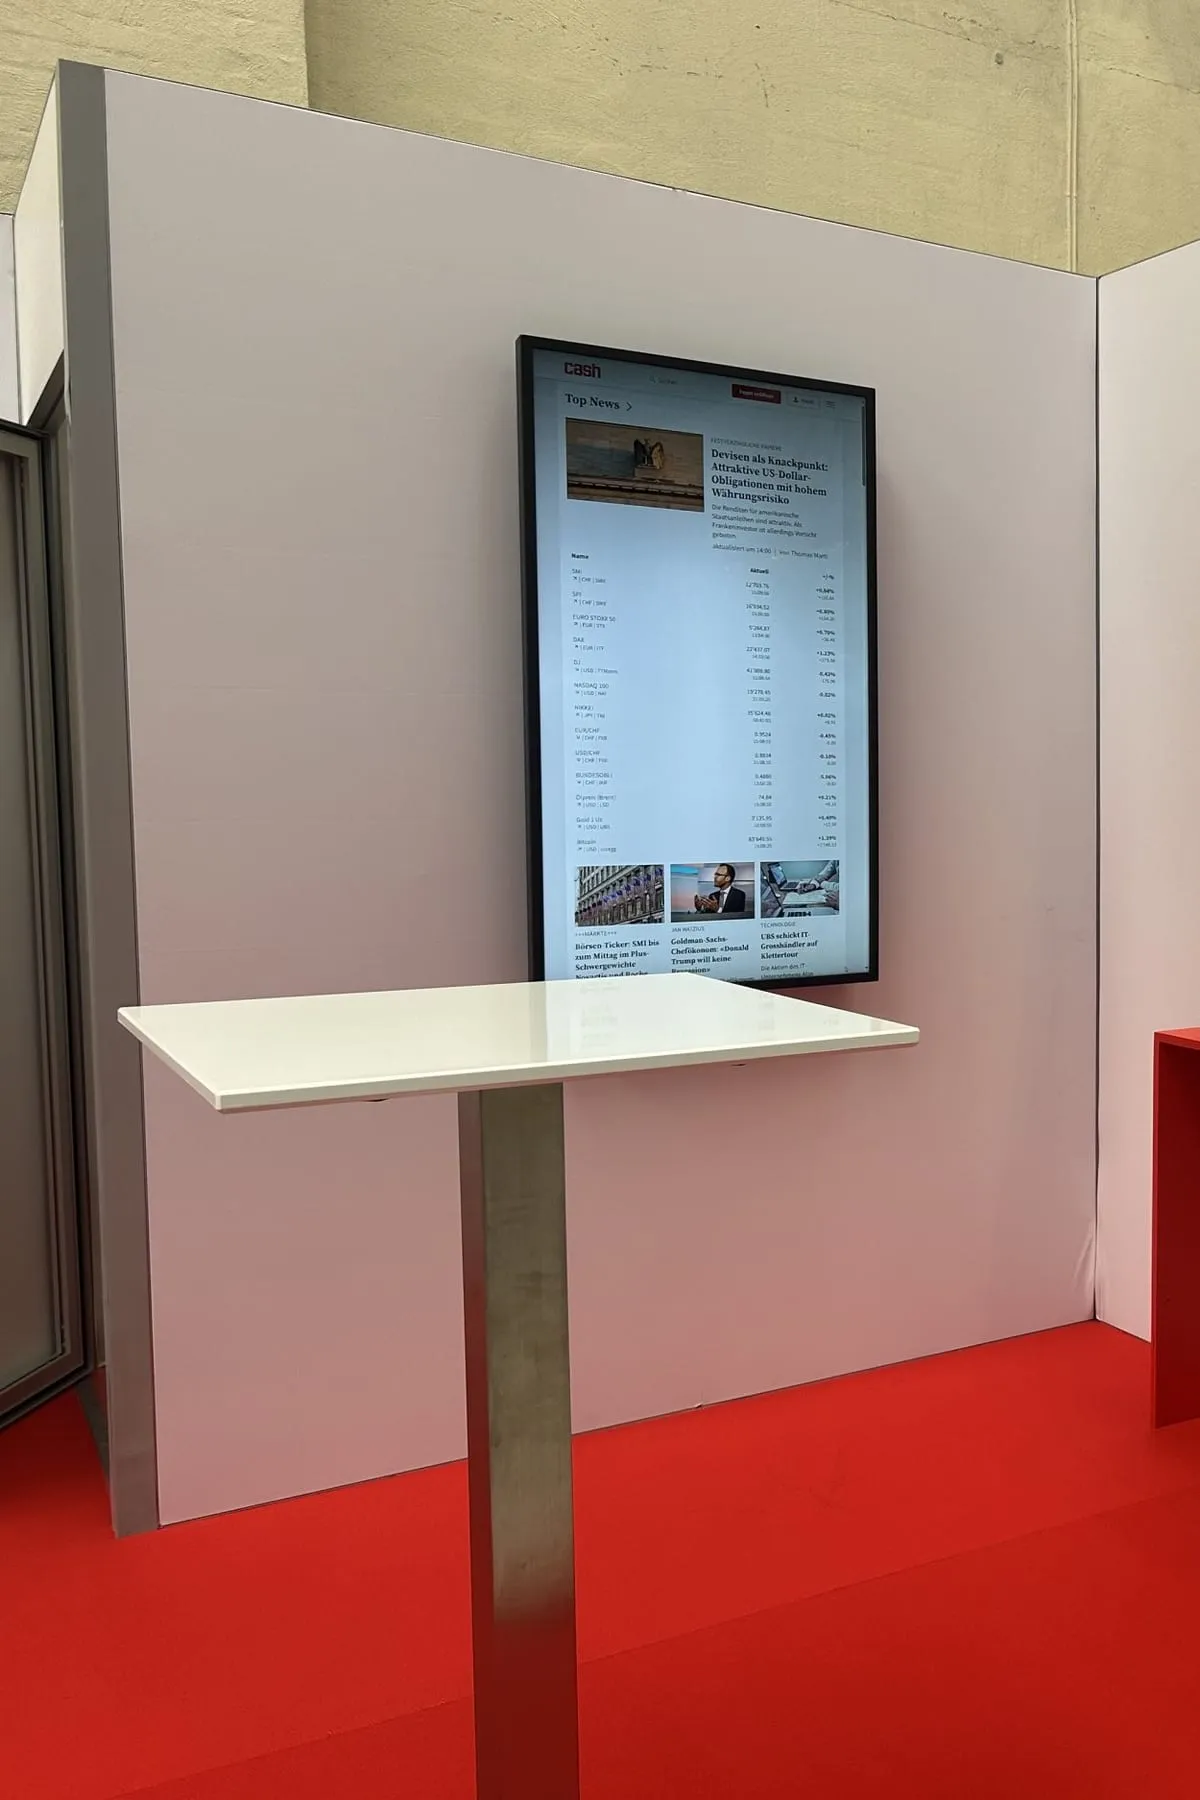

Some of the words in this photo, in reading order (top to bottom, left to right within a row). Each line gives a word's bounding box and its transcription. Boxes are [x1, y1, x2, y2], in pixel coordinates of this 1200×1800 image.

[564, 362, 601, 378] cash
[565, 393, 587, 407] Top
[590, 396, 620, 410] News
[711, 449, 750, 461] Devisen
[751, 454, 766, 464] als
[768, 456, 828, 471] Knackpunkt:
[711, 463, 760, 475] Attraktive
[762, 468, 811, 481] US-Dollar-
[711, 475, 774, 490] Obligationen
[776, 483, 792, 492] mit
[794, 484, 827, 496] hohem
[712, 488, 790, 504] Währungsrisiko
[760, 932, 775, 940] UBS
[648, 938, 660, 946] bis
[760, 941, 805, 950] Grosshändler
[593, 952, 618, 960] Mittag
[619, 950, 630, 958] im
[671, 957, 696, 965] Trump
[697, 955, 711, 963] will
[712, 955, 732, 963] keine
[760, 951, 798, 960] Klettertour
[575, 961, 636, 971] Schwergewichte
